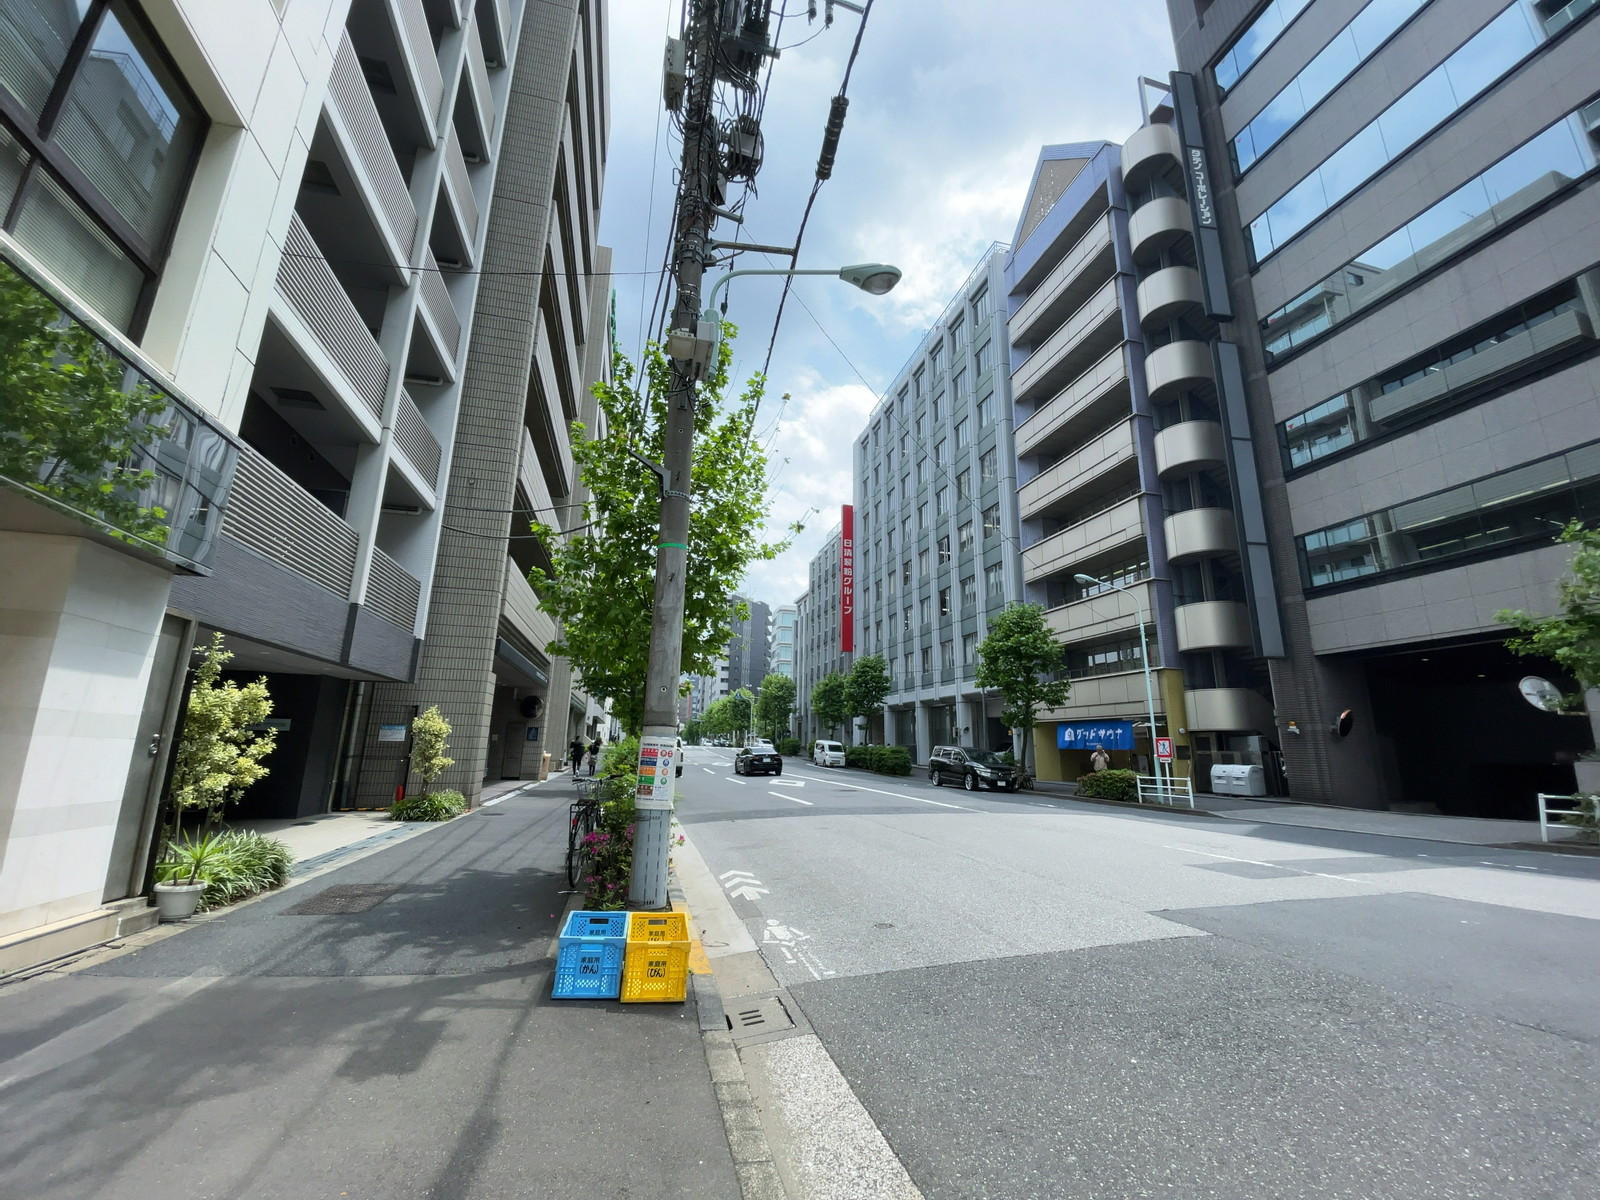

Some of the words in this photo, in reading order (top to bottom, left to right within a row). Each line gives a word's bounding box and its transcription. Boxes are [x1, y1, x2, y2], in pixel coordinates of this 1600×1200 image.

[843, 539, 853, 615] 日清製粉グループ
[581, 956, 600, 964] 家庭用
[579, 964, 599, 975] (かん)
[646, 967, 666, 978] (びん)
